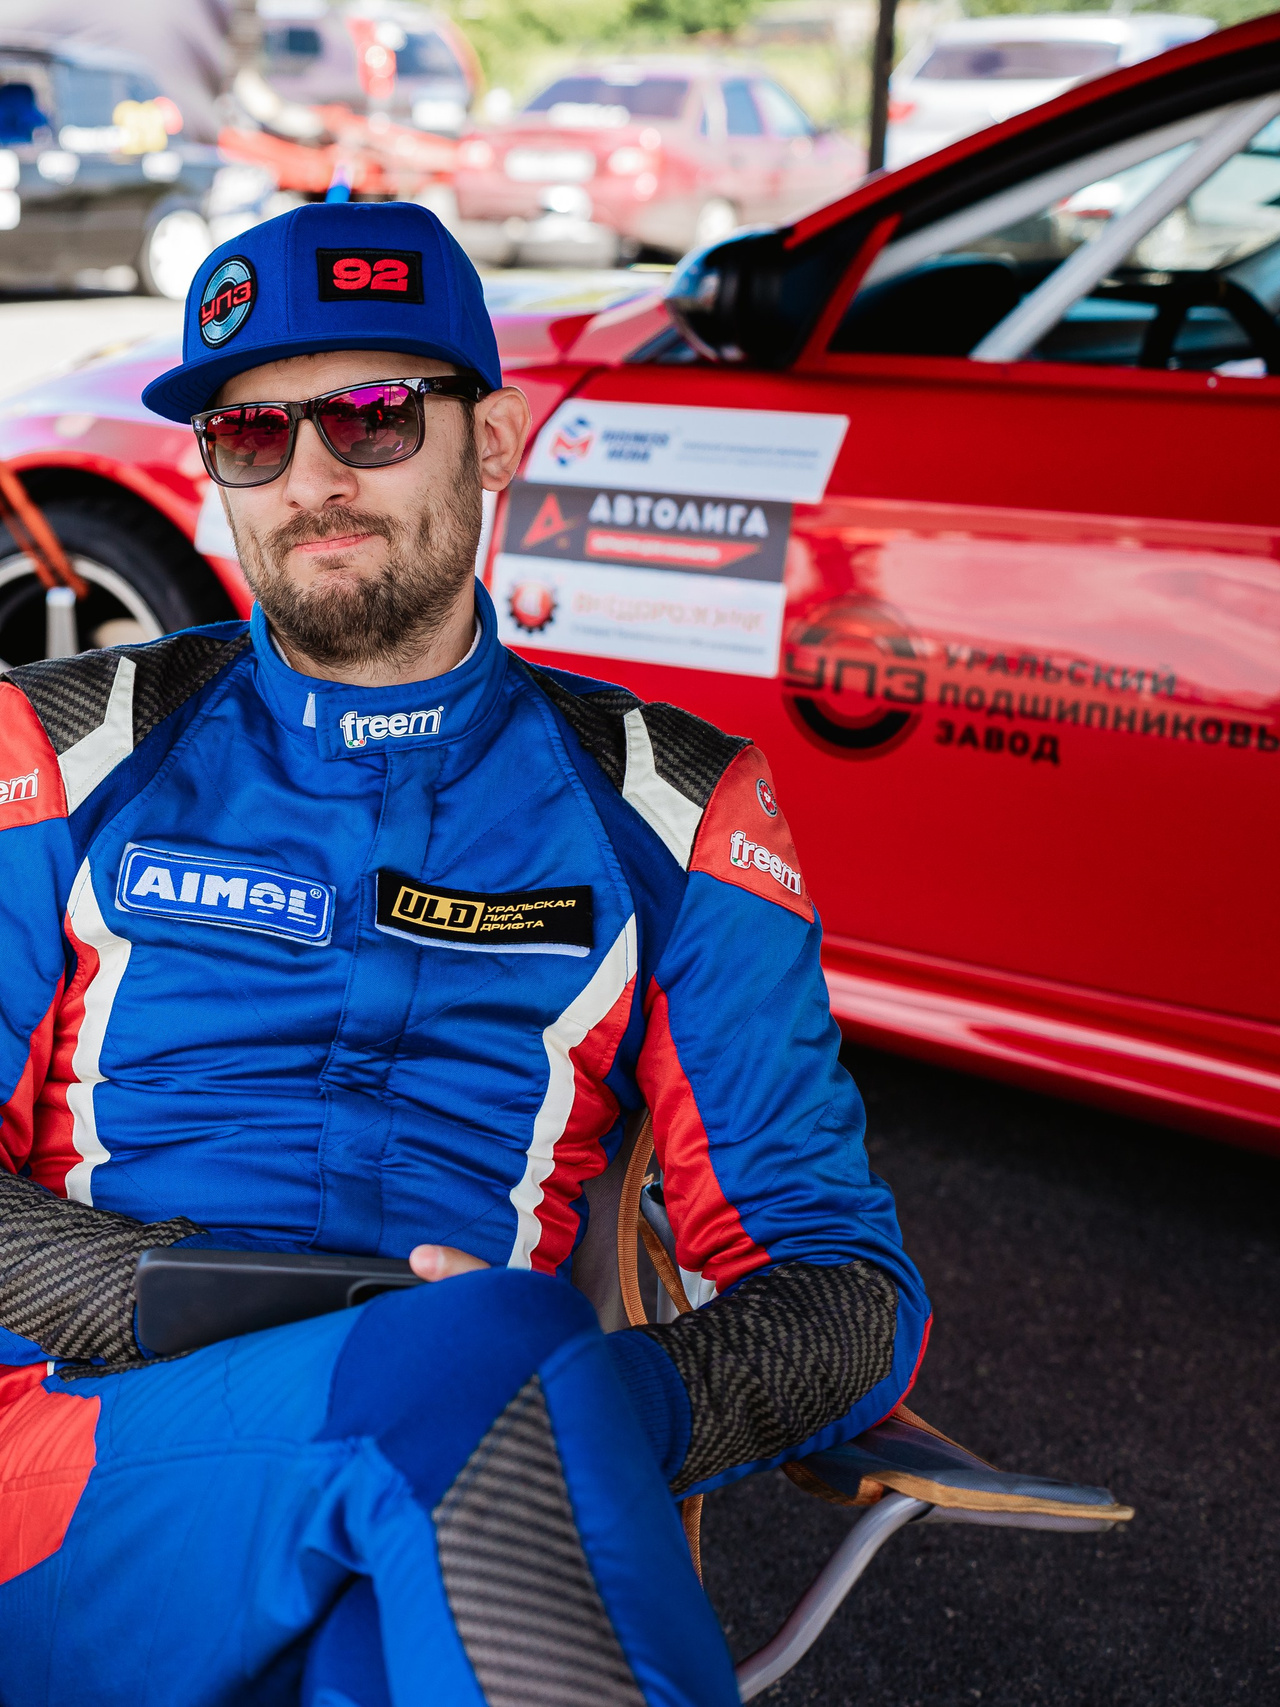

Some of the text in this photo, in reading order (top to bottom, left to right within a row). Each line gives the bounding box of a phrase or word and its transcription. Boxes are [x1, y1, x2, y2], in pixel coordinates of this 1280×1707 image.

[332, 257, 409, 292] 92
[201, 280, 252, 327] УПЗ
[588, 493, 769, 538] АВТОЛИГА
[784, 652, 927, 705] УПЗ
[944, 644, 1177, 697] УРАЛЬСКИЙ
[340, 709, 442, 748] freem
[935, 718, 1061, 767] ЗАВОД
[730, 830, 801, 895] freem
[396, 889, 480, 930] ULD
[479, 919, 545, 932] ДРИФТА
[482, 913, 524, 922] ЛИГА
[486, 899, 577, 914] УРАЛЬСКАЯ
